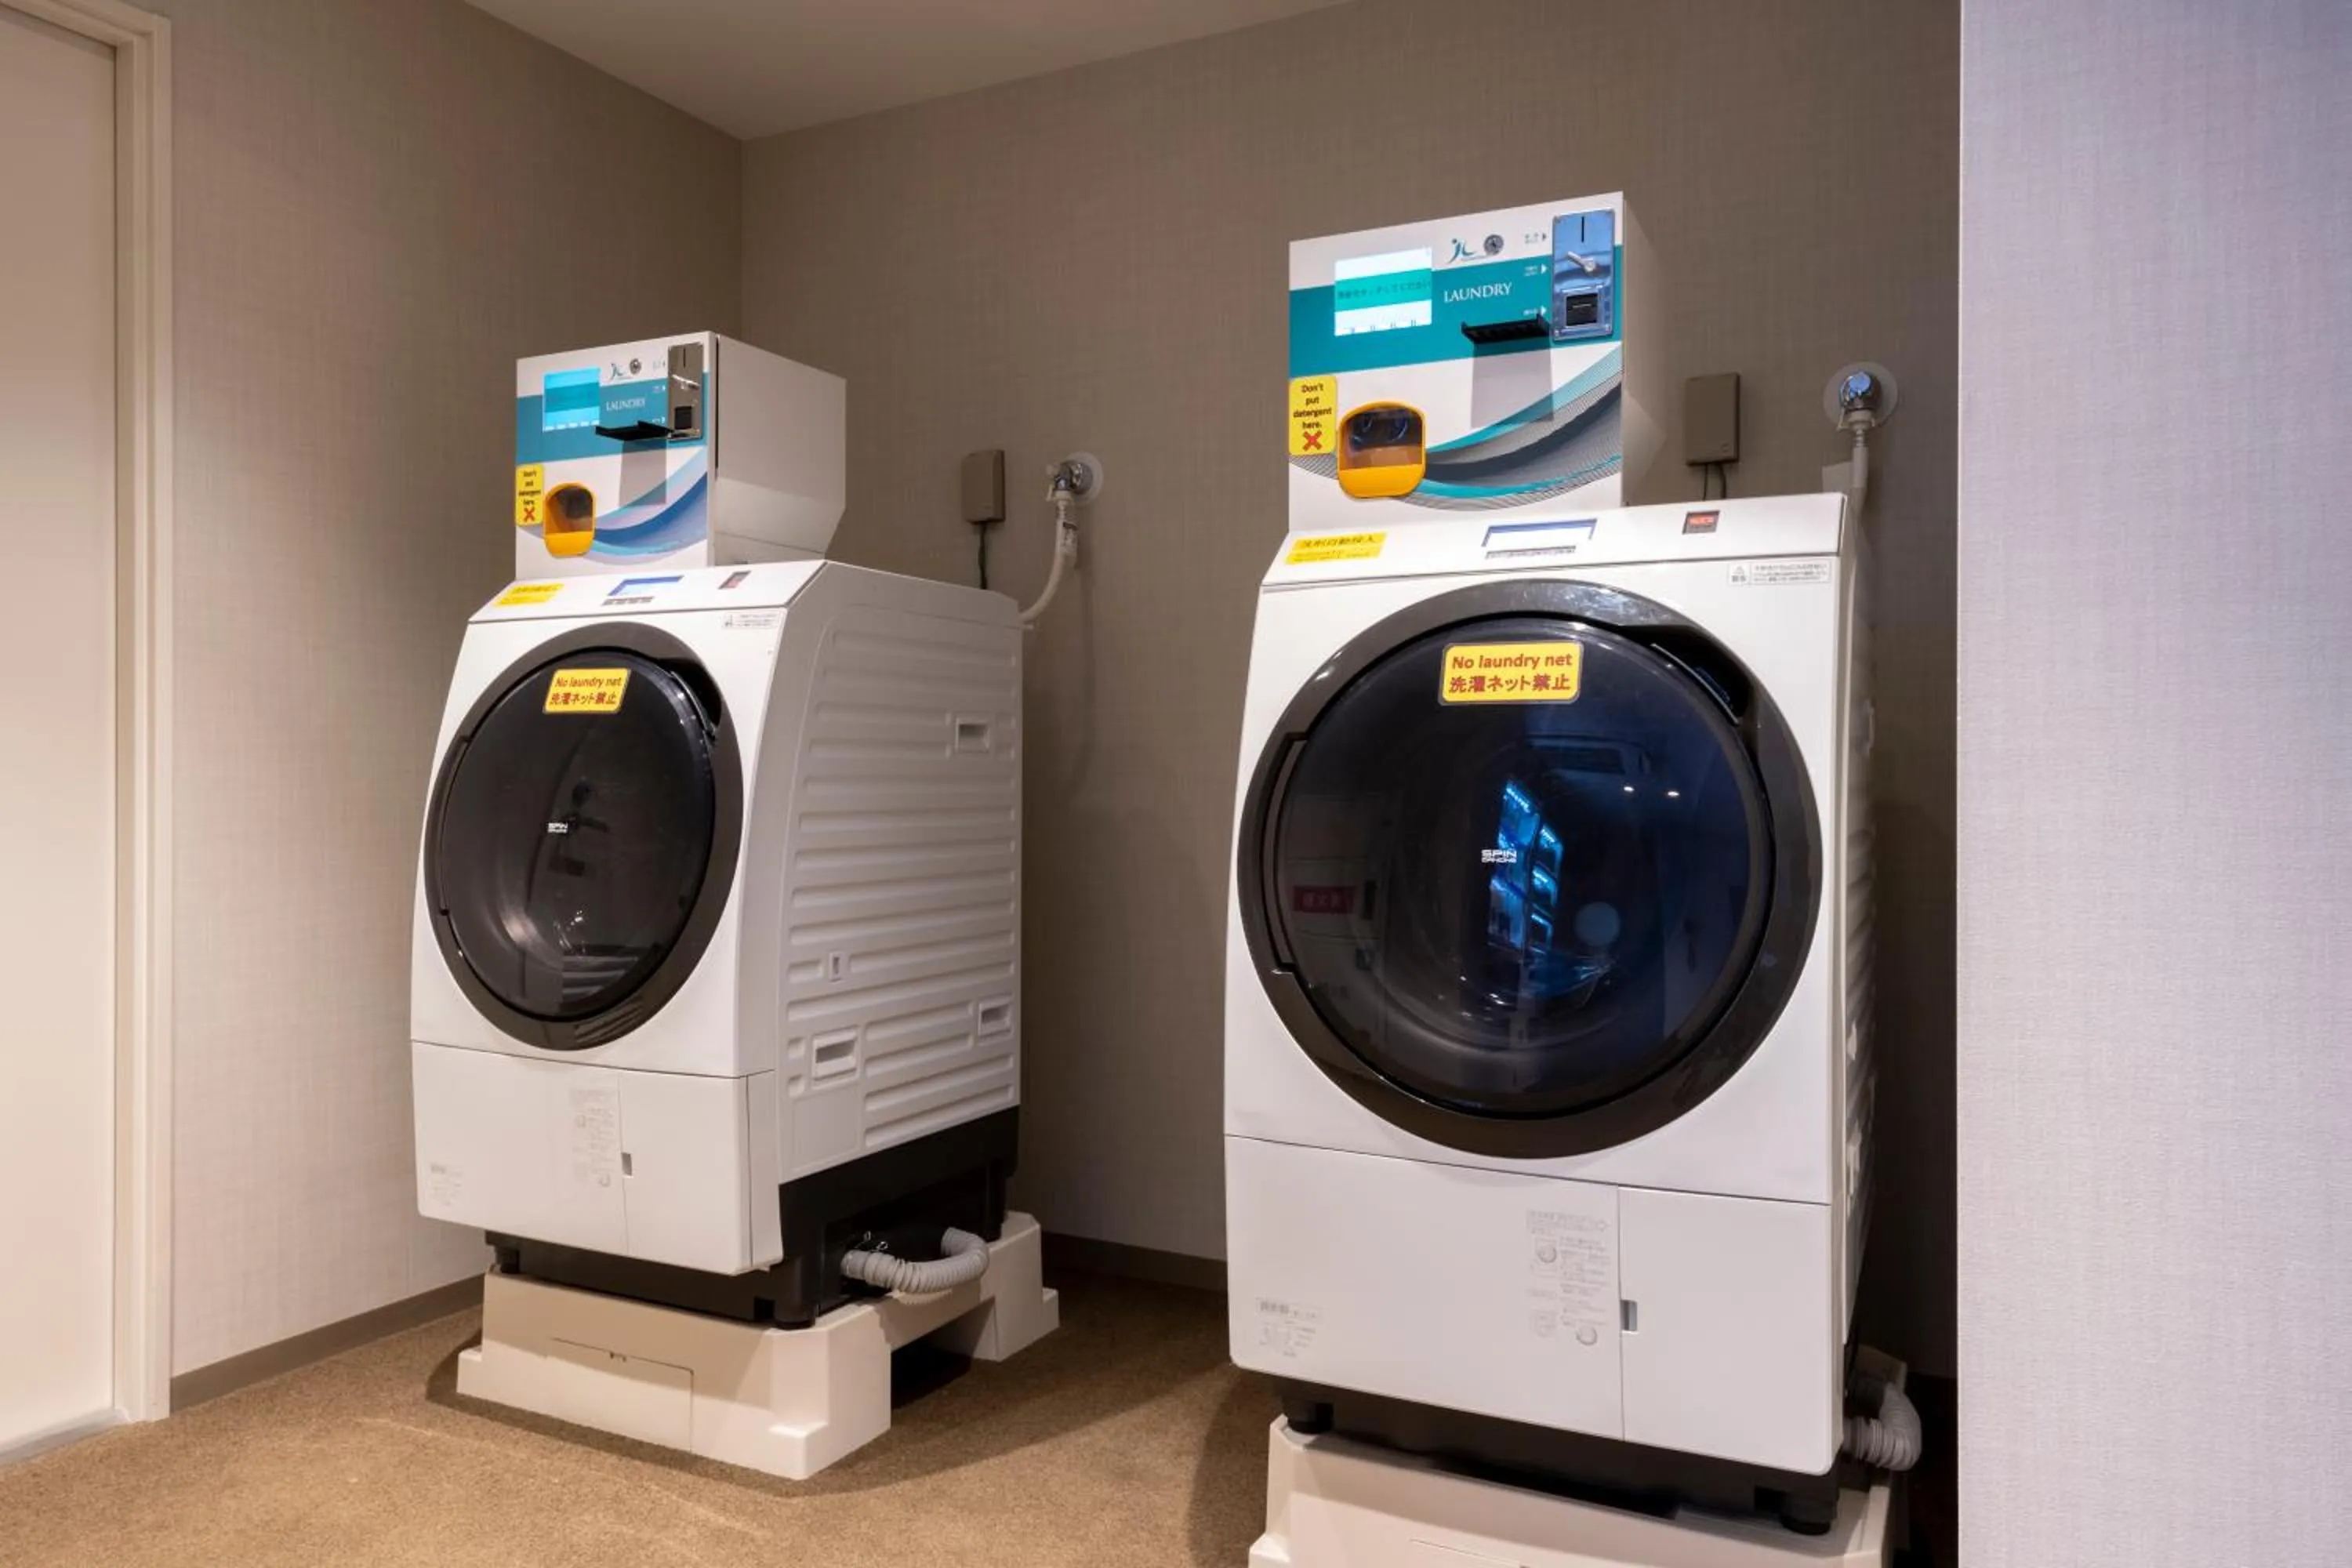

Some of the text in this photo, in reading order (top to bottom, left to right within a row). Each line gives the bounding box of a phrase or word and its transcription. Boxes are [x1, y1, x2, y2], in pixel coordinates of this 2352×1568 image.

[1443, 282, 1512, 303] LAUNDRY
[1301, 383, 1323, 393] Don't
[1305, 396, 1319, 405] put
[1293, 407, 1332, 418] detergent
[1452, 653, 1573, 670] No laundry net
[555, 677, 622, 688] No laundry net
[1449, 673, 1570, 694] 洗濯ネット禁止
[1481, 850, 1517, 858] SPIN
